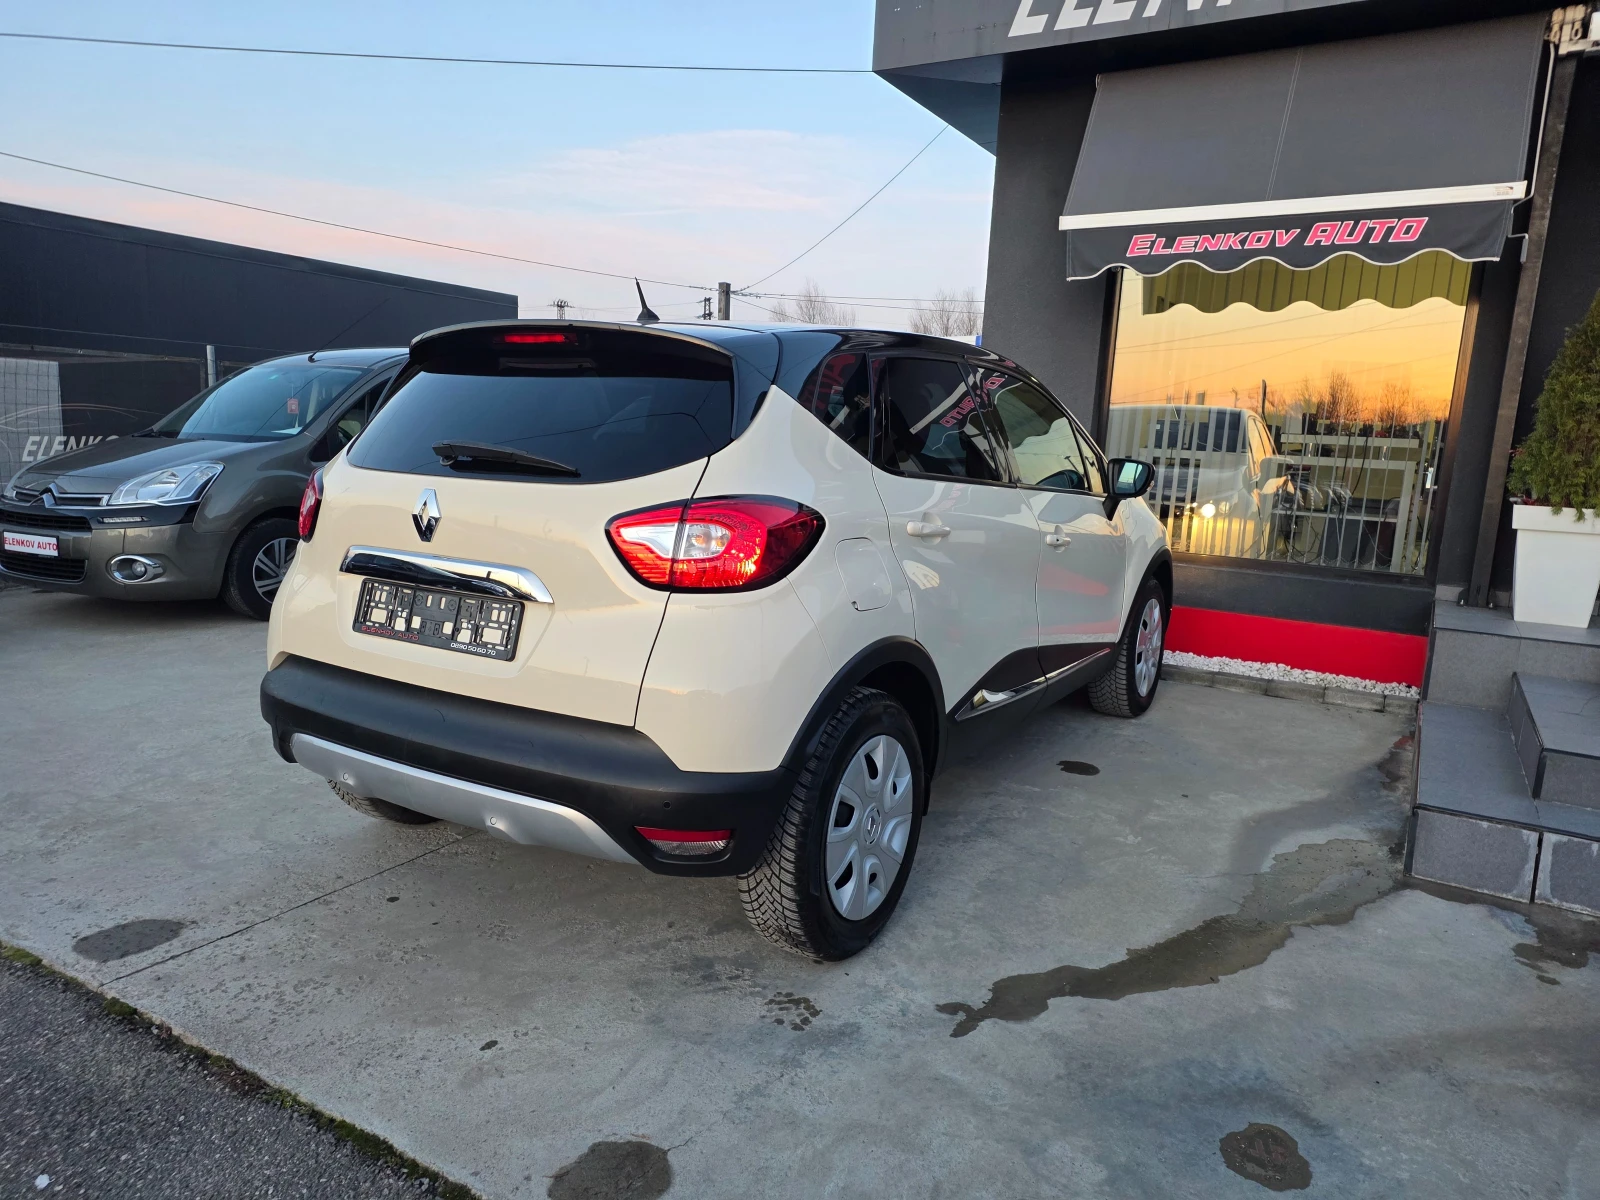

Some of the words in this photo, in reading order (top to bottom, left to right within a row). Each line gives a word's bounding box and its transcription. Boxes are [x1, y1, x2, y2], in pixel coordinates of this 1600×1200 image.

[1126, 228, 1300, 257] ELENKOV
[1304, 217, 1429, 246] AUTO
[3, 536, 35, 549] ELENKOV
[37, 541, 59, 552] AUTO
[361, 625, 396, 636] ELENKOV
[397, 632, 419, 641] AUTO
